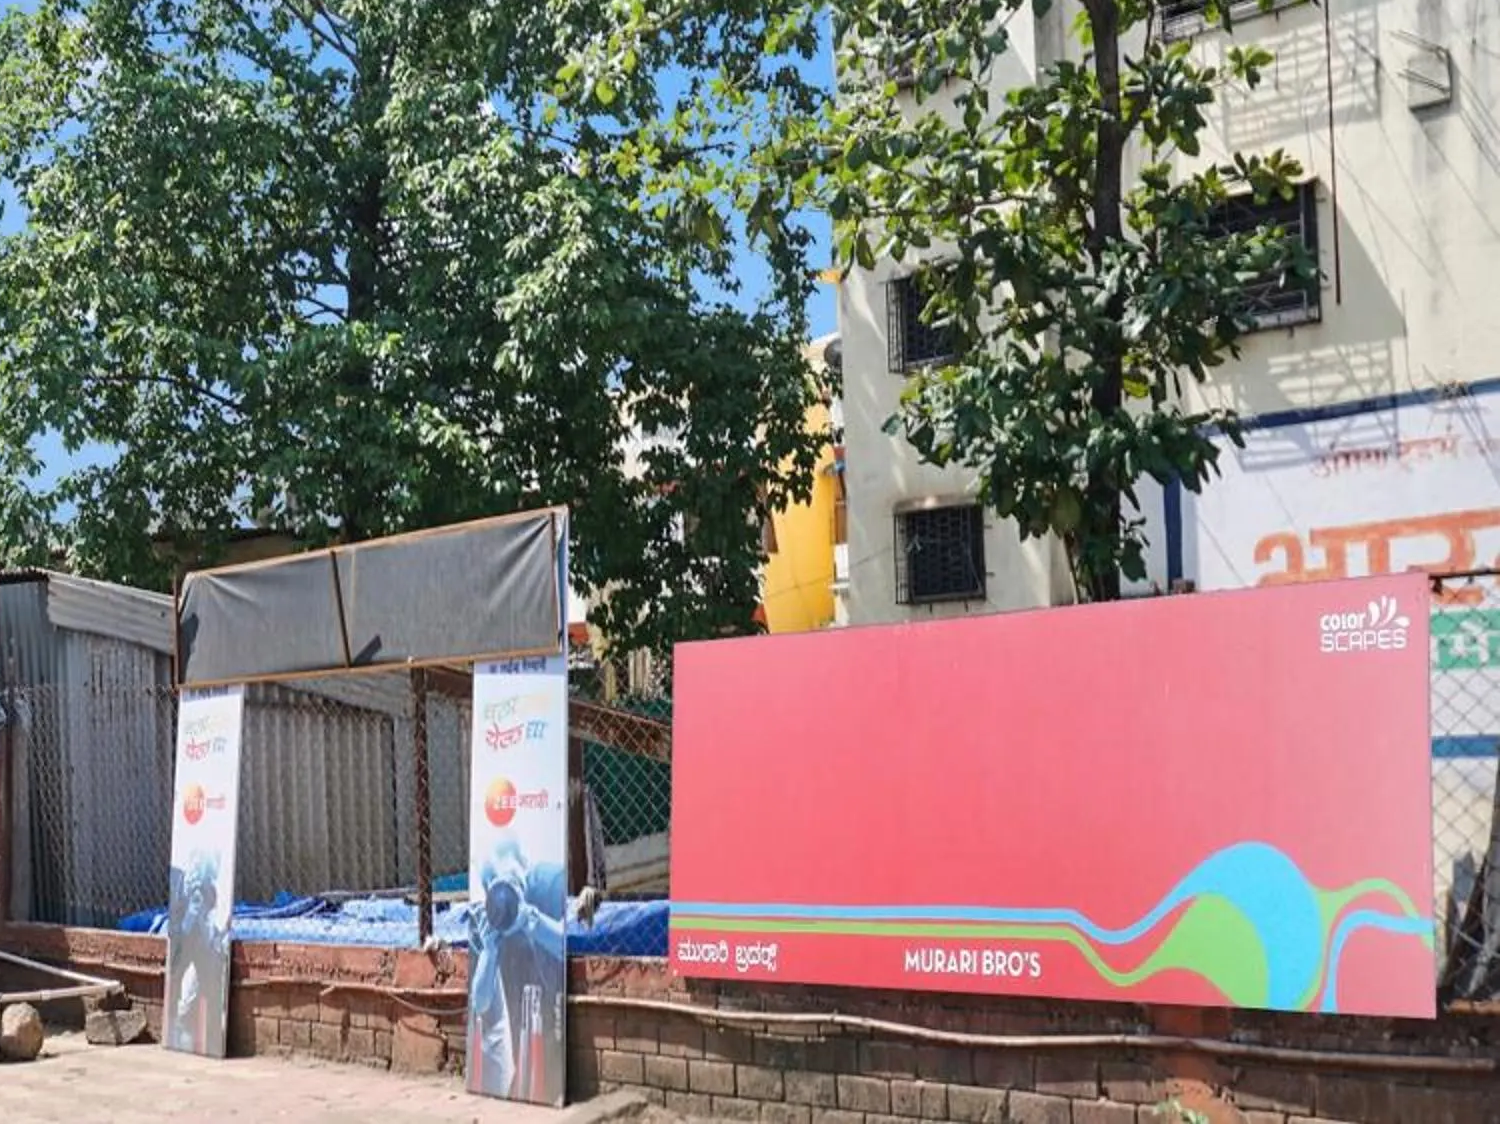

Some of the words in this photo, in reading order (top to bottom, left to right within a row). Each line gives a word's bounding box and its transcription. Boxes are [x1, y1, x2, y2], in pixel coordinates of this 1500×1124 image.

[1320, 613, 1366, 631] color
[1320, 628, 1407, 652] SCAPES
[905, 949, 978, 974] MURARI
[982, 951, 1041, 978] BRO'S
